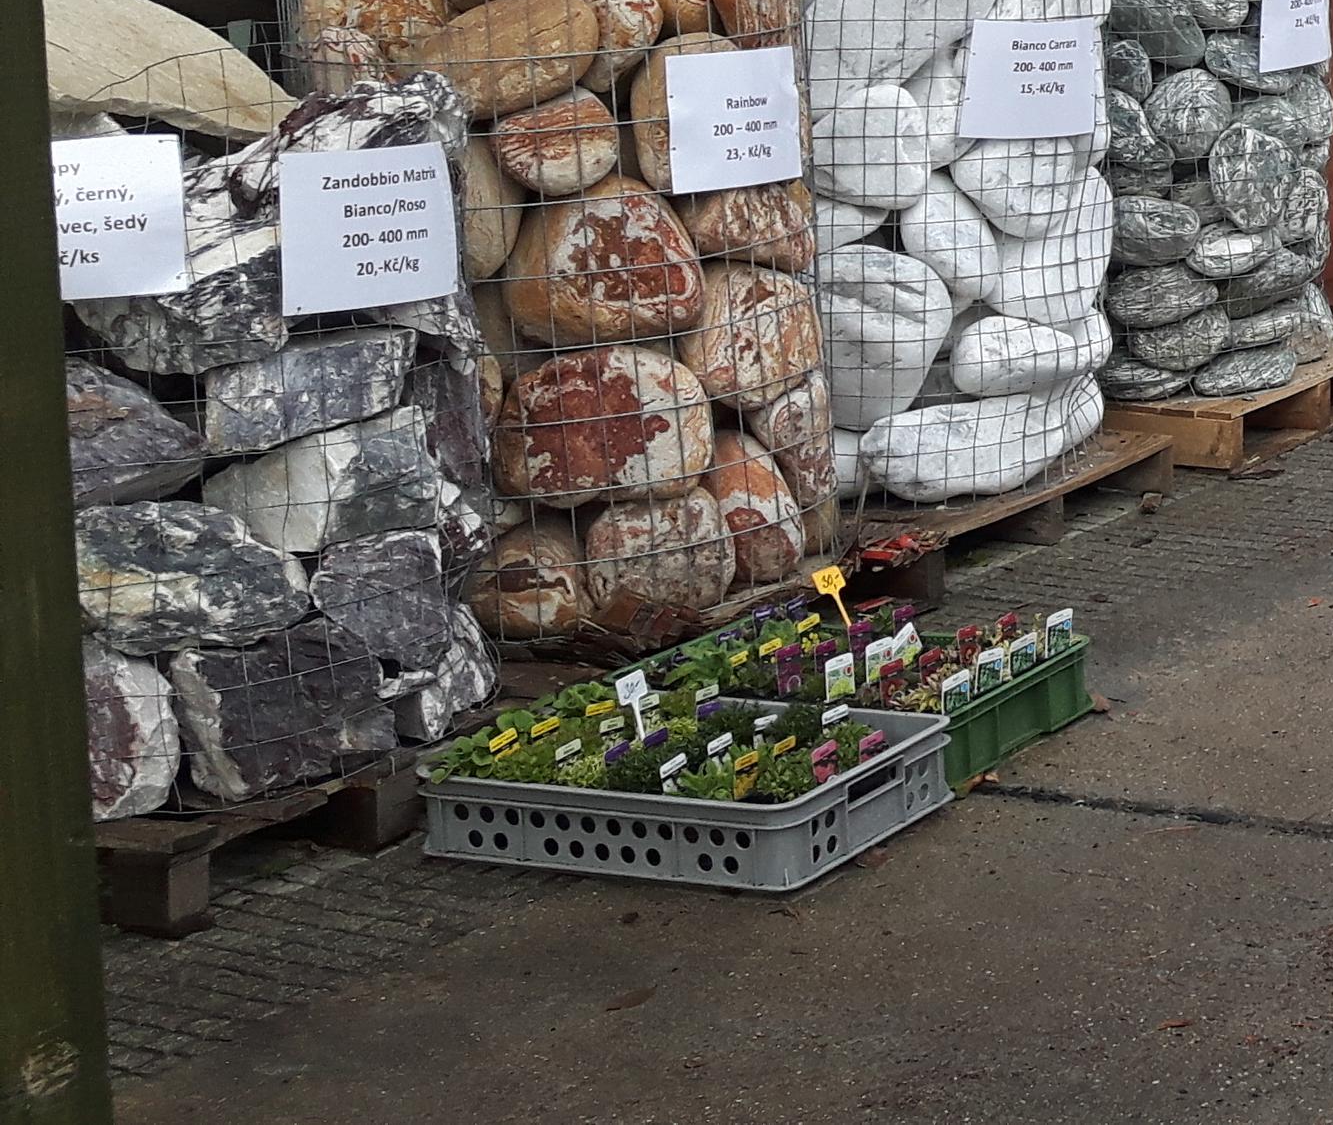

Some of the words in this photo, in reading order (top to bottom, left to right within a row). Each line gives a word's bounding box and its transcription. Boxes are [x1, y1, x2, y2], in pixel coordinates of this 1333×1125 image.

[1012, 40, 1047, 51] Bianco
[1048, 39, 1077, 50] Carrara
[1058, 61, 1074, 70] mm
[726, 95, 768, 110] Rainbow
[713, 122, 734, 136] 200
[745, 120, 761, 132] 400
[763, 119, 778, 130] mm
[322, 172, 400, 191] Zandobbio
[75, 184, 134, 203] černý,
[344, 198, 427, 219] Bianco/Roso
[103, 213, 148, 232] šedý
[406, 228, 429, 242] mm
[356, 255, 420, 277] 20,-Kč/kg
